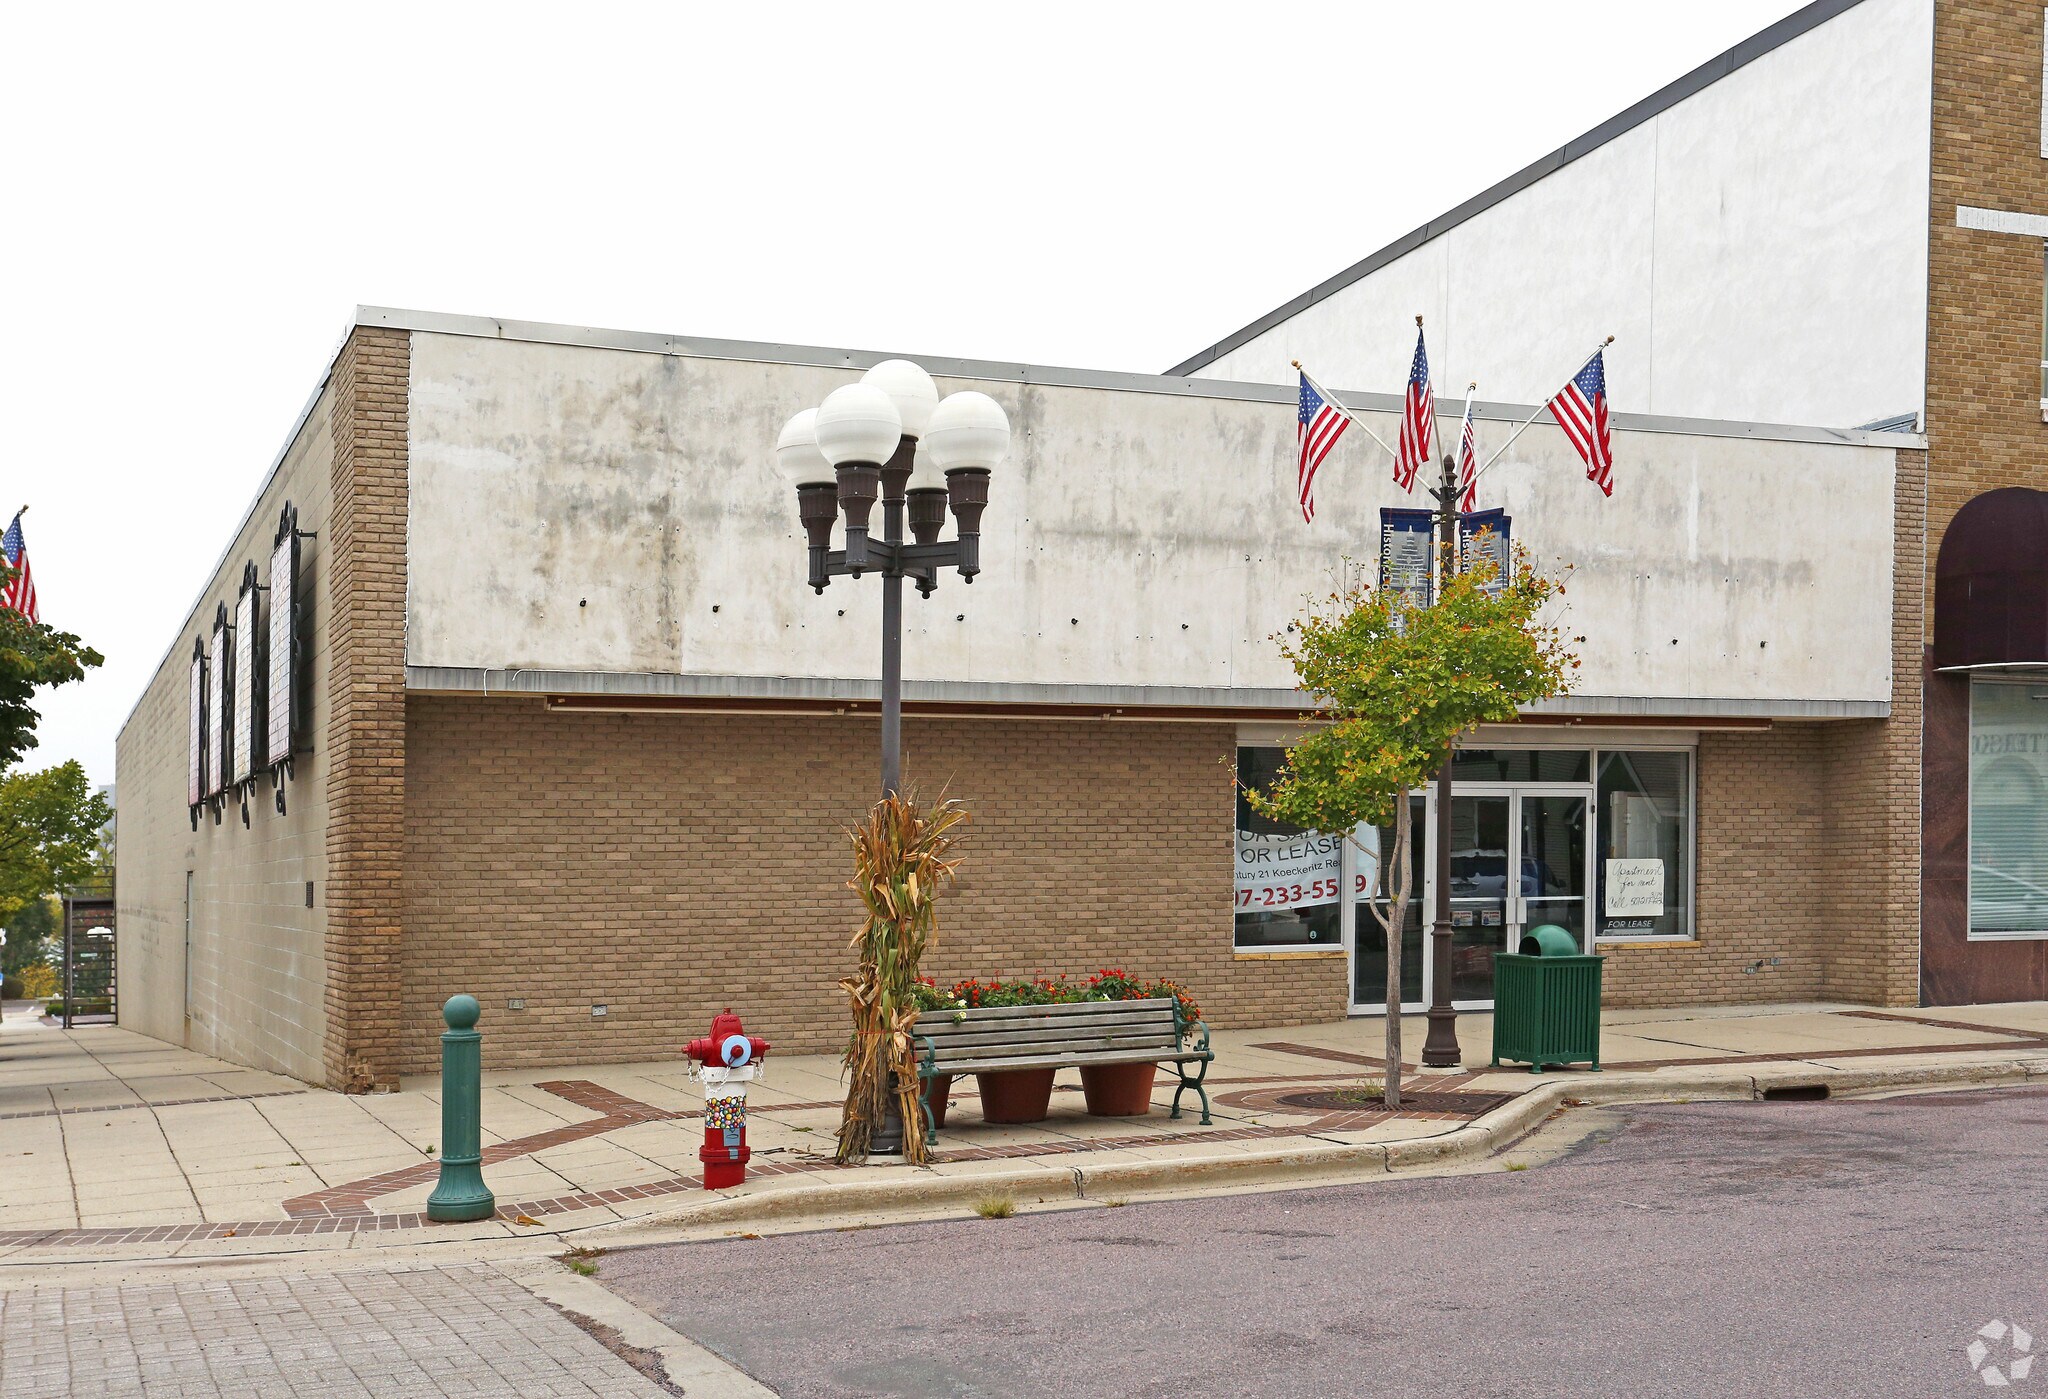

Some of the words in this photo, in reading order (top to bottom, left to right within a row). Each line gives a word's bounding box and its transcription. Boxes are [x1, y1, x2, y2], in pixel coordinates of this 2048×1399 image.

[1278, 836, 1341, 862] LEASE
[1258, 870, 1270, 879] 21
[1272, 862, 1323, 878] Koeckeritz
[1607, 920, 1626, 928] FOR
[1628, 920, 1653, 928] LEASE
